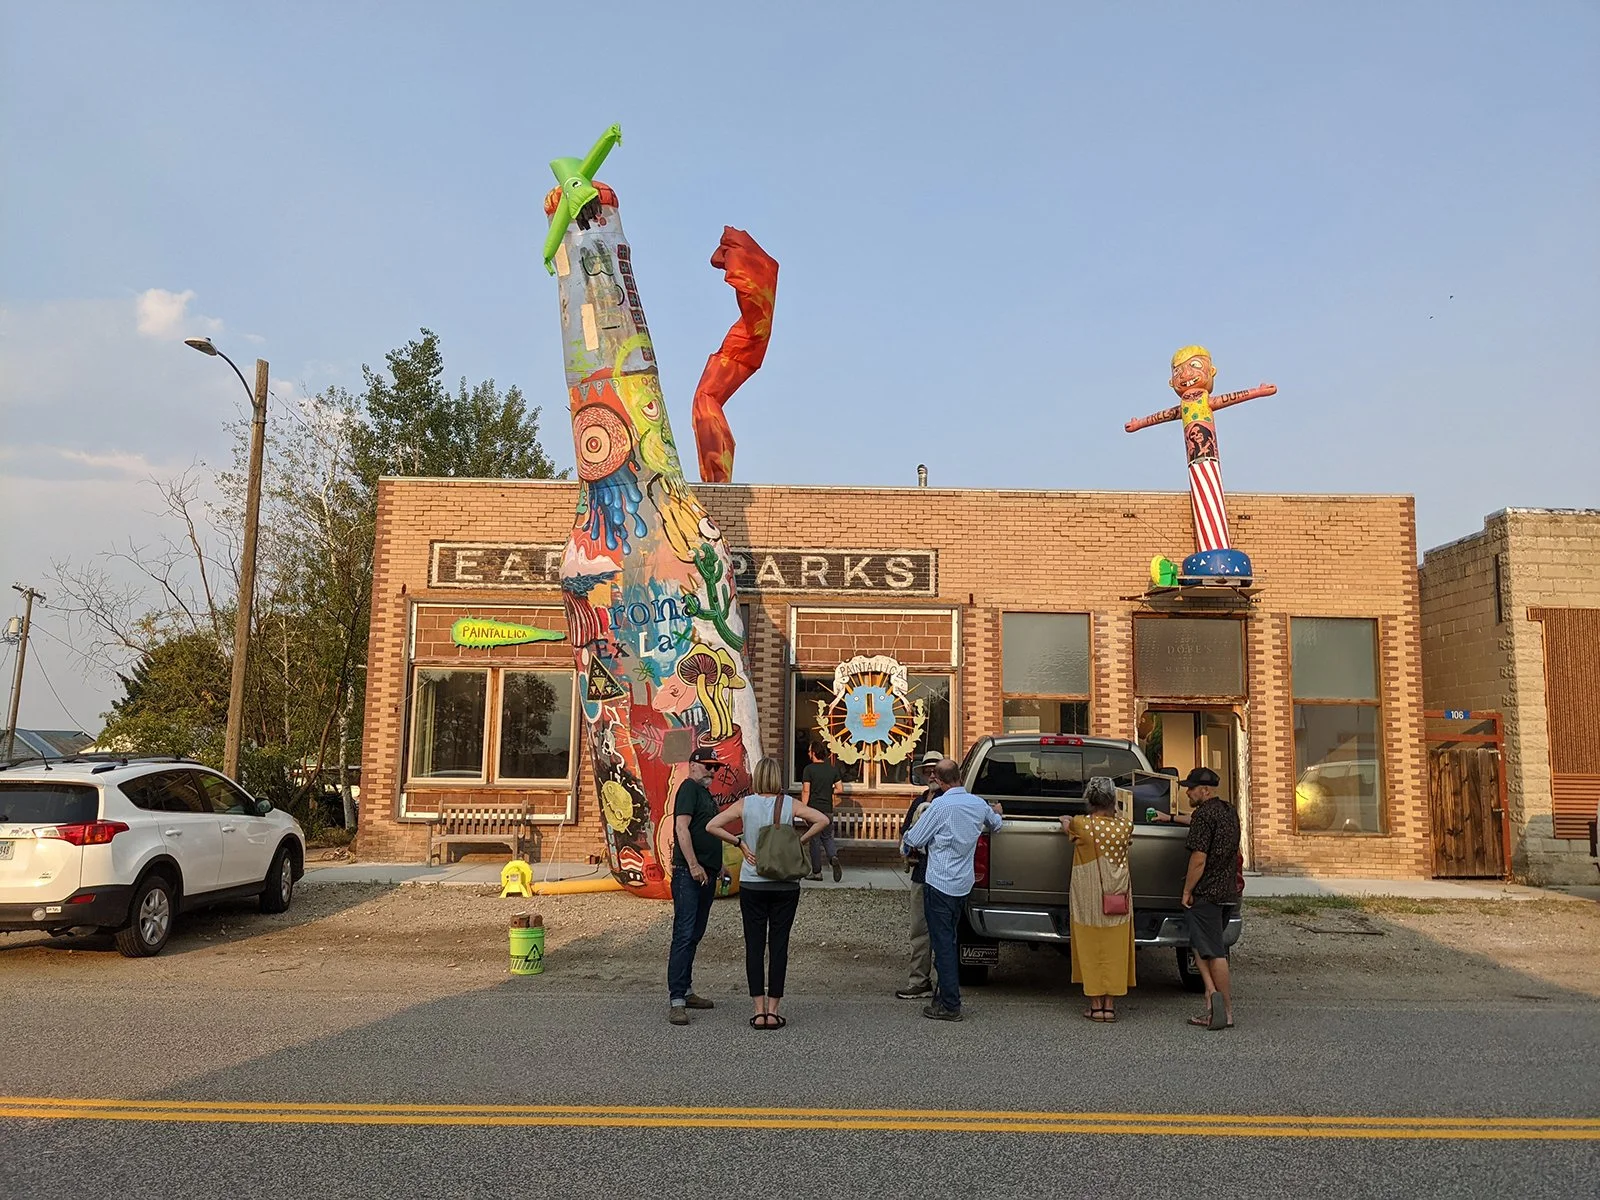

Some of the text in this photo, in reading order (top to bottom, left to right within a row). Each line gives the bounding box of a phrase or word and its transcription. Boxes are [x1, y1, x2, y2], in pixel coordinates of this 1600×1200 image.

[731, 554, 915, 588] PARKS
[462, 625, 528, 639] PAINTALLICA
[839, 661, 905, 679] PAINTALLICA
[1450, 710, 1464, 720] 106
